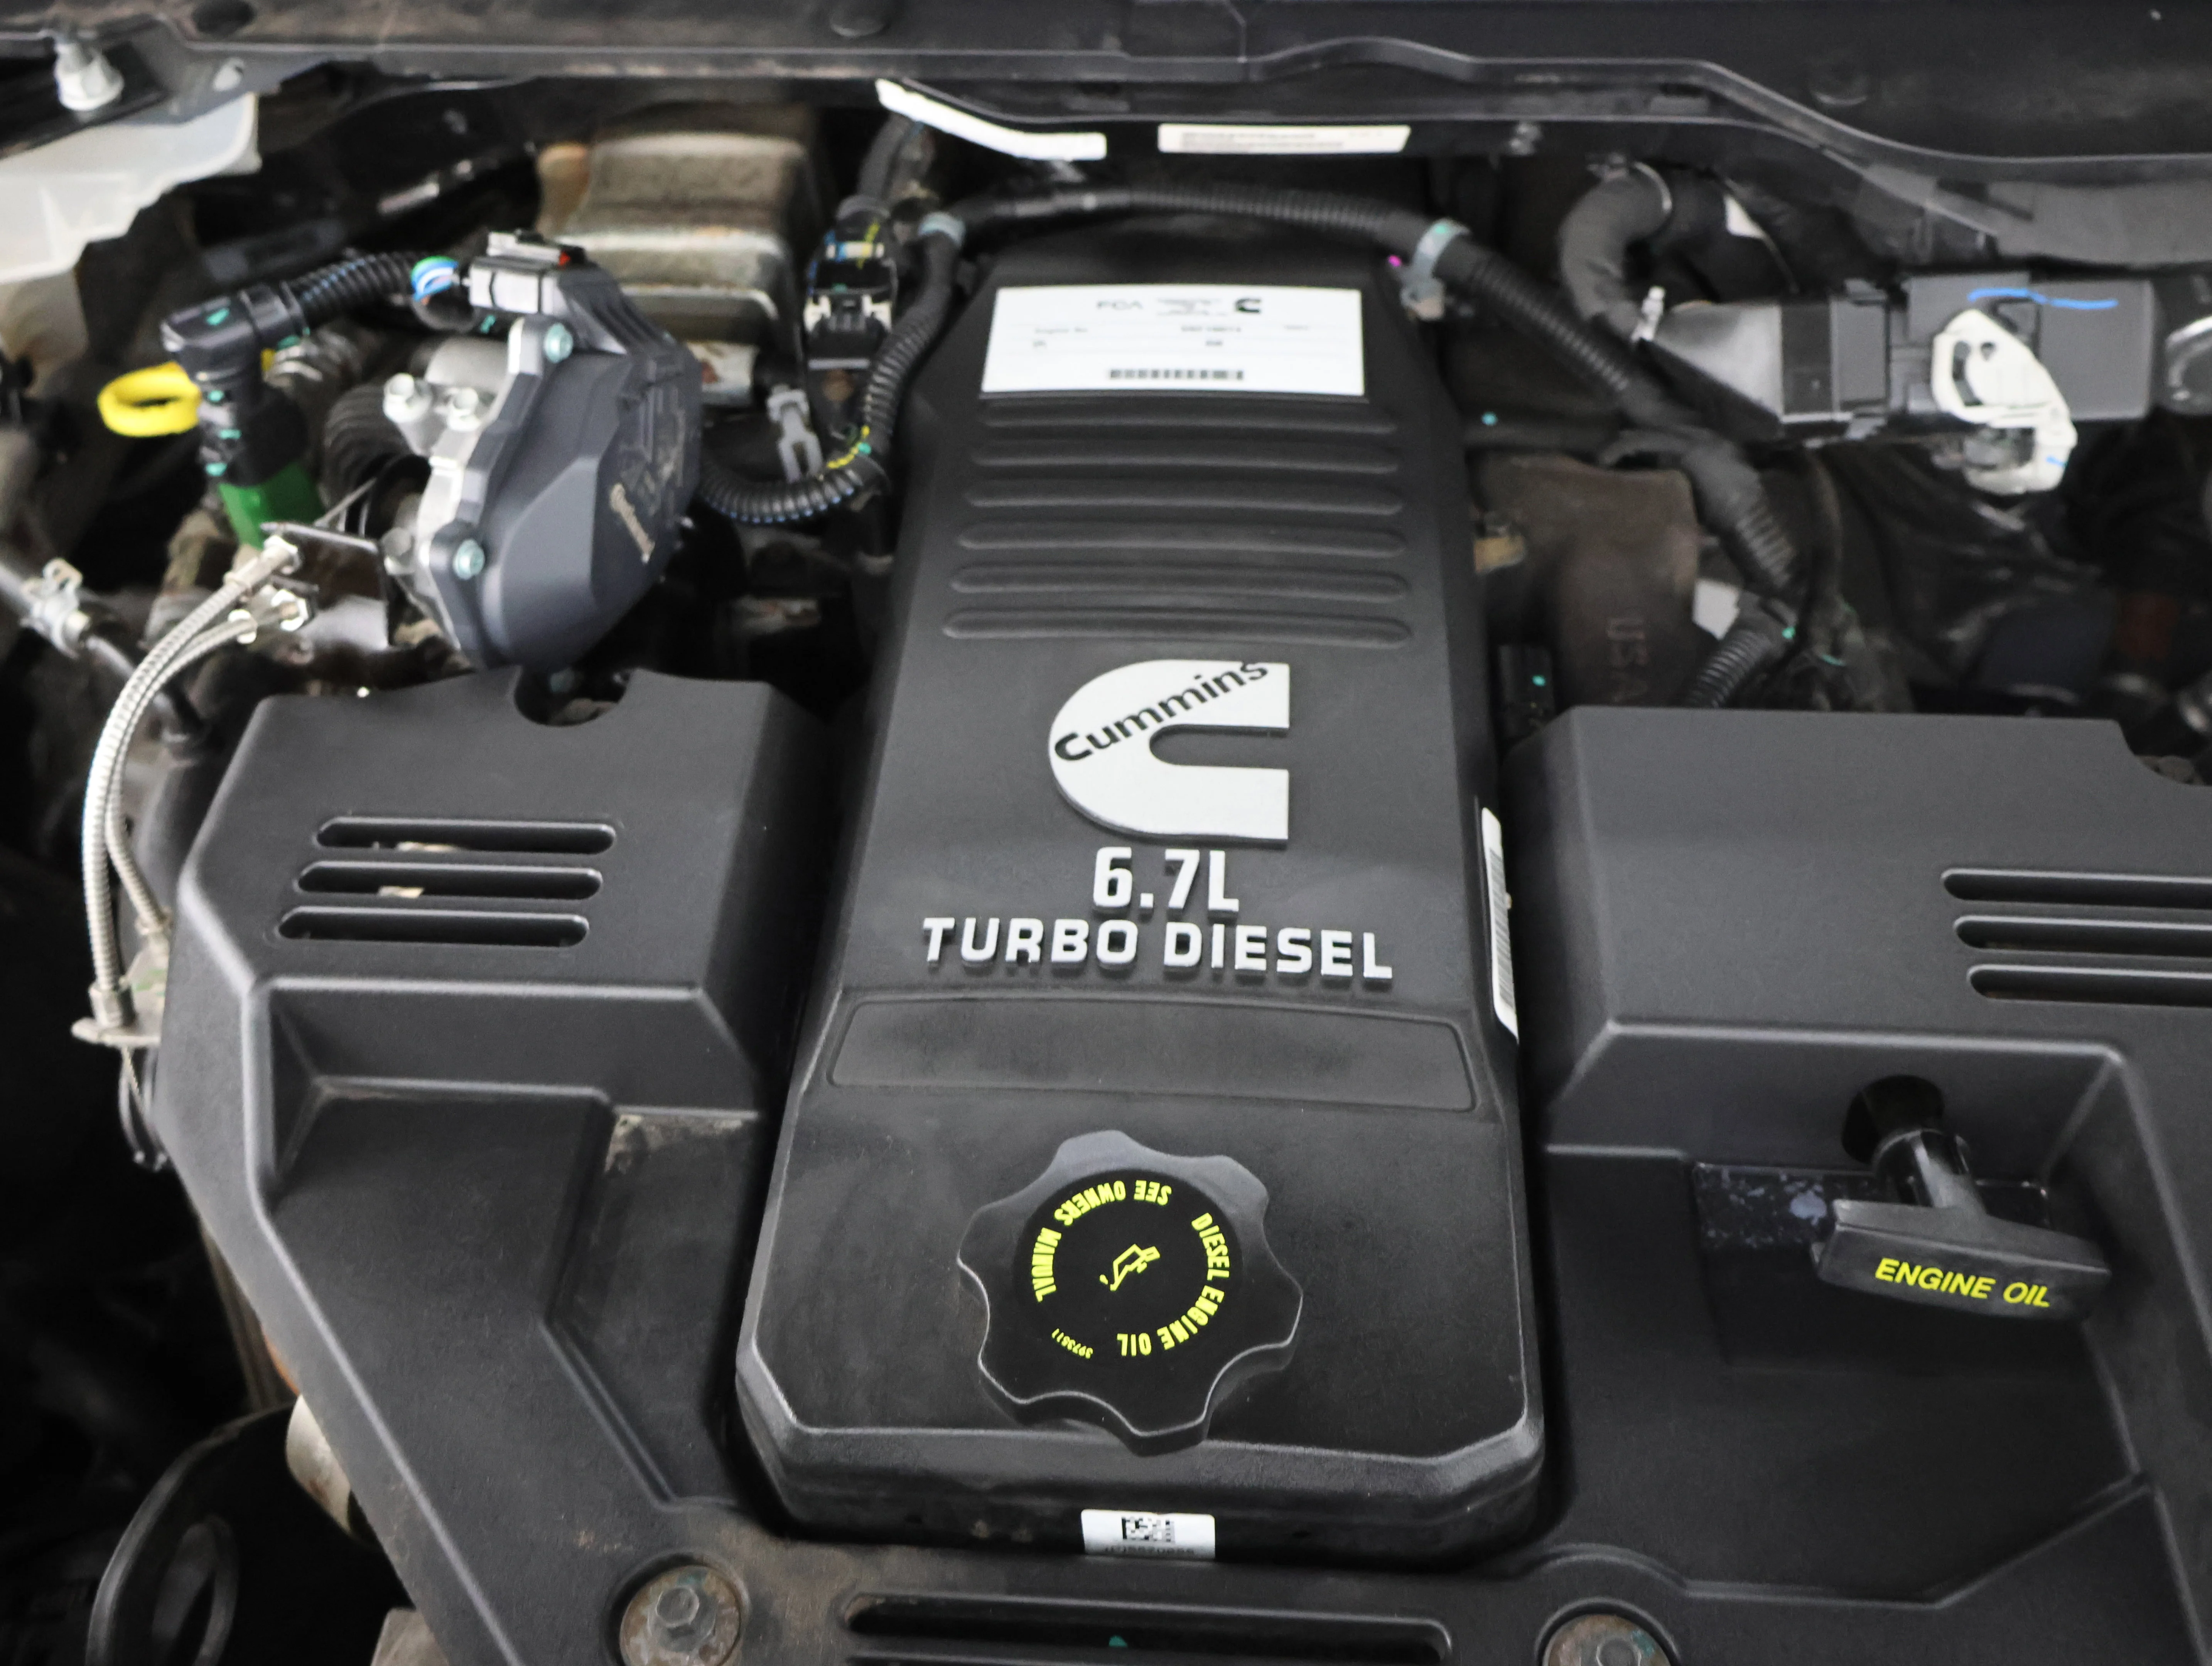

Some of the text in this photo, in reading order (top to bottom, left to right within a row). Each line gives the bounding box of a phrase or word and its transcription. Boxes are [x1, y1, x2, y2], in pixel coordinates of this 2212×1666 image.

[1055, 661, 1268, 761] Cummins
[1093, 847, 1239, 912] 6.7L
[923, 917, 1392, 979] TURBO DIESEL
[1031, 1180, 1173, 1302] SEE OWNERS MANUAL
[1116, 1212, 1230, 1357] DIESEL ENGINE OIL
[1875, 1257, 2050, 1308] ENGINE OIL
[1051, 1329, 1094, 1359] 3973511
